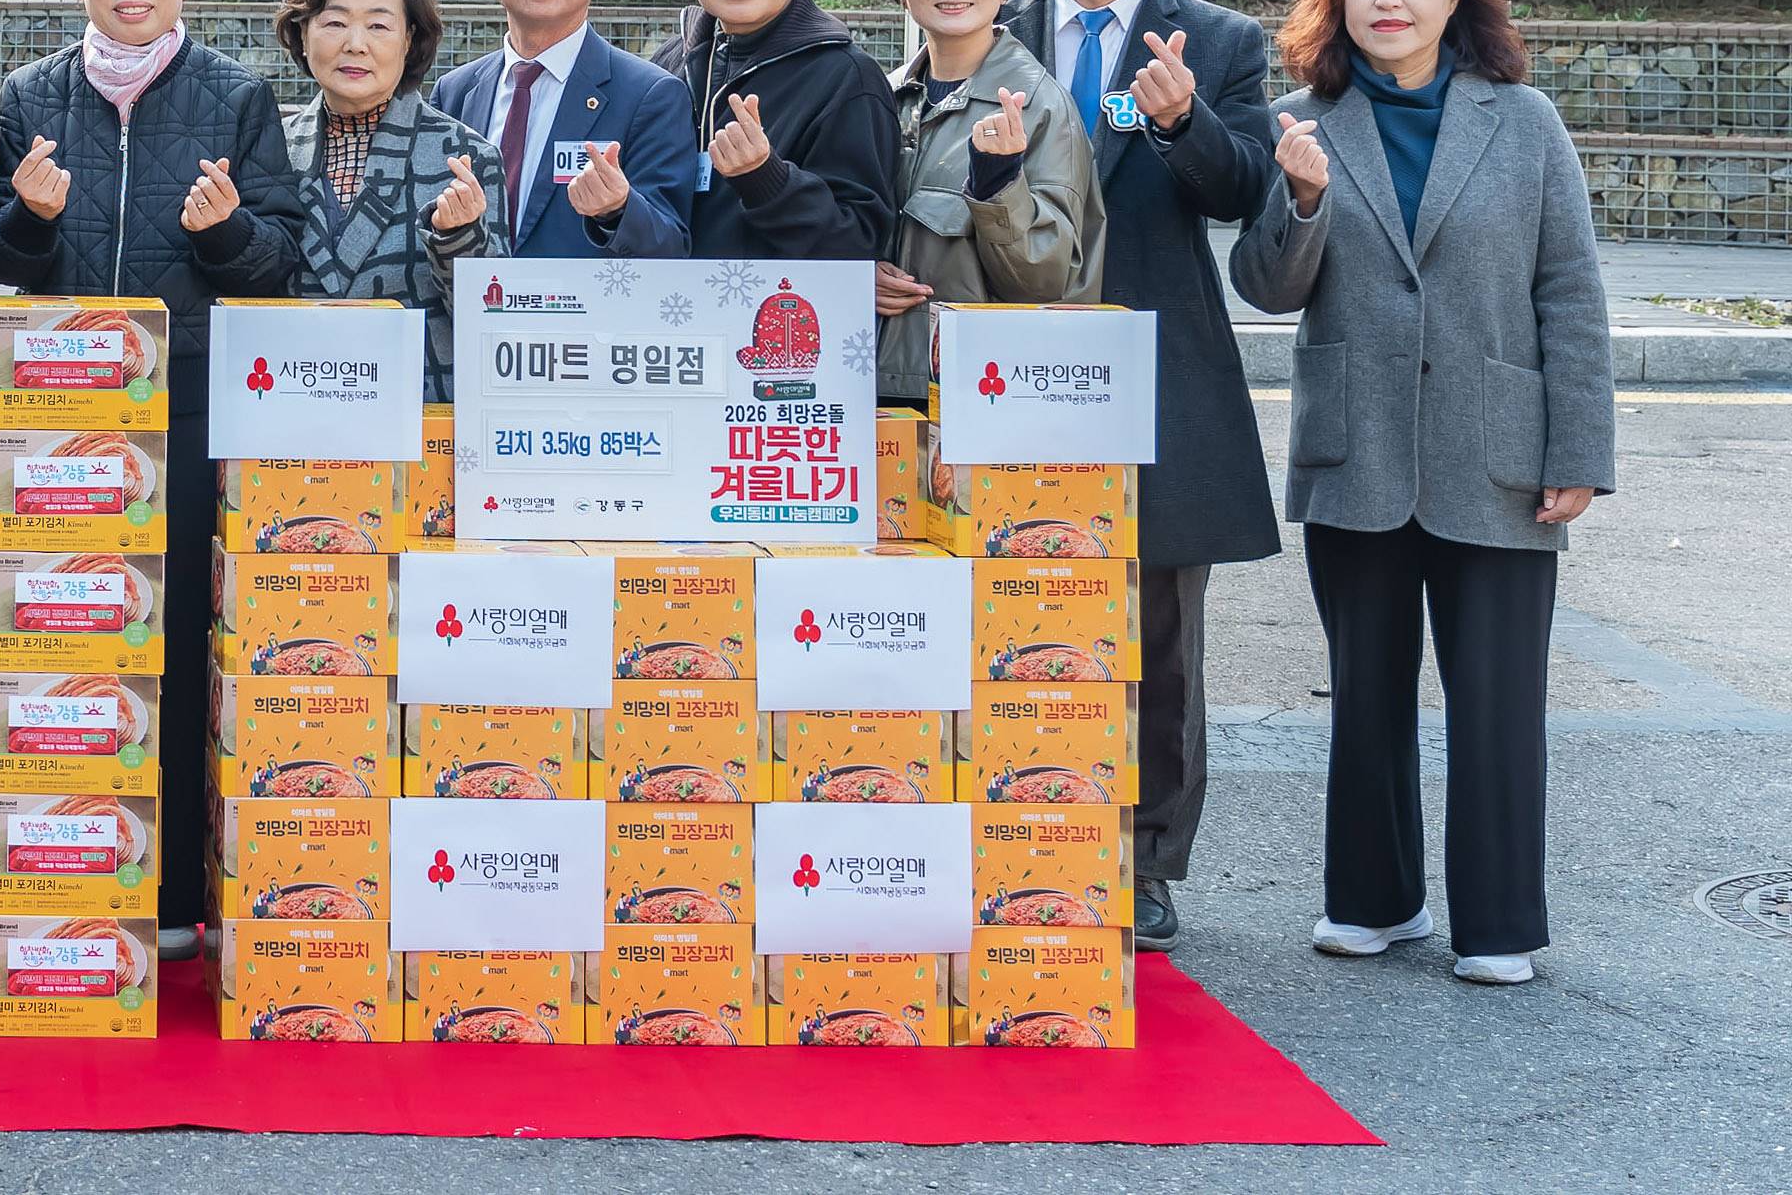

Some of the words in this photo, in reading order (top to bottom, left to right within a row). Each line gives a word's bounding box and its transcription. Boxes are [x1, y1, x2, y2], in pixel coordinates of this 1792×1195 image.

[505, 294, 543, 309] 기부로
[495, 341, 589, 382] 이마트
[611, 342, 705, 385] 명일점
[279, 361, 378, 387] 사랑의열매
[1011, 364, 1110, 392] 사랑의열매
[725, 405, 767, 423] 2026
[777, 404, 845, 424] 희망온돌
[494, 430, 533, 456] 김치
[542, 431, 591, 457] 3.5kg
[600, 431, 662, 457] 85박스
[728, 425, 841, 462] 따뜻한
[711, 465, 859, 502] 겨울나기
[719, 506, 775, 521] 우리동네
[780, 506, 851, 522] 나눔캠페인
[254, 575, 300, 591] 희망의
[307, 575, 369, 592] 김장김치
[620, 579, 666, 594] 희망의
[673, 578, 735, 594] 김장김치
[992, 580, 1039, 596] 희망의
[1046, 579, 1107, 596] 김장김치
[468, 607, 568, 634] 사랑의열매
[826, 611, 926, 638] 사랑의열매
[0, 637, 18, 648] 별미
[23, 638, 62, 648] 포기김치
[56, 704, 79, 721] 강동
[254, 697, 300, 713] 희망의
[307, 697, 368, 713] 김장김치
[623, 701, 669, 717] 희망의
[676, 701, 738, 718] 김장김치
[991, 702, 1037, 719] 희망의
[1044, 703, 1106, 719] 김장김치
[256, 821, 302, 836] 희망의
[309, 820, 370, 836] 김장김치
[618, 824, 664, 840] 희망의
[671, 823, 733, 840] 김장김치
[984, 824, 1031, 841] 희망의
[1038, 826, 1100, 842] 김장김치
[460, 852, 560, 878] 사랑의열매
[825, 856, 926, 883] 사랑의열매
[254, 941, 300, 957] 희망의
[307, 942, 368, 958] 김장김치
[618, 946, 664, 962] 희망의
[671, 945, 733, 962] 김장김치
[987, 948, 1034, 964] 희망의
[1041, 947, 1103, 964] 김장김치
[18, 1002, 56, 1013] 포기김치
